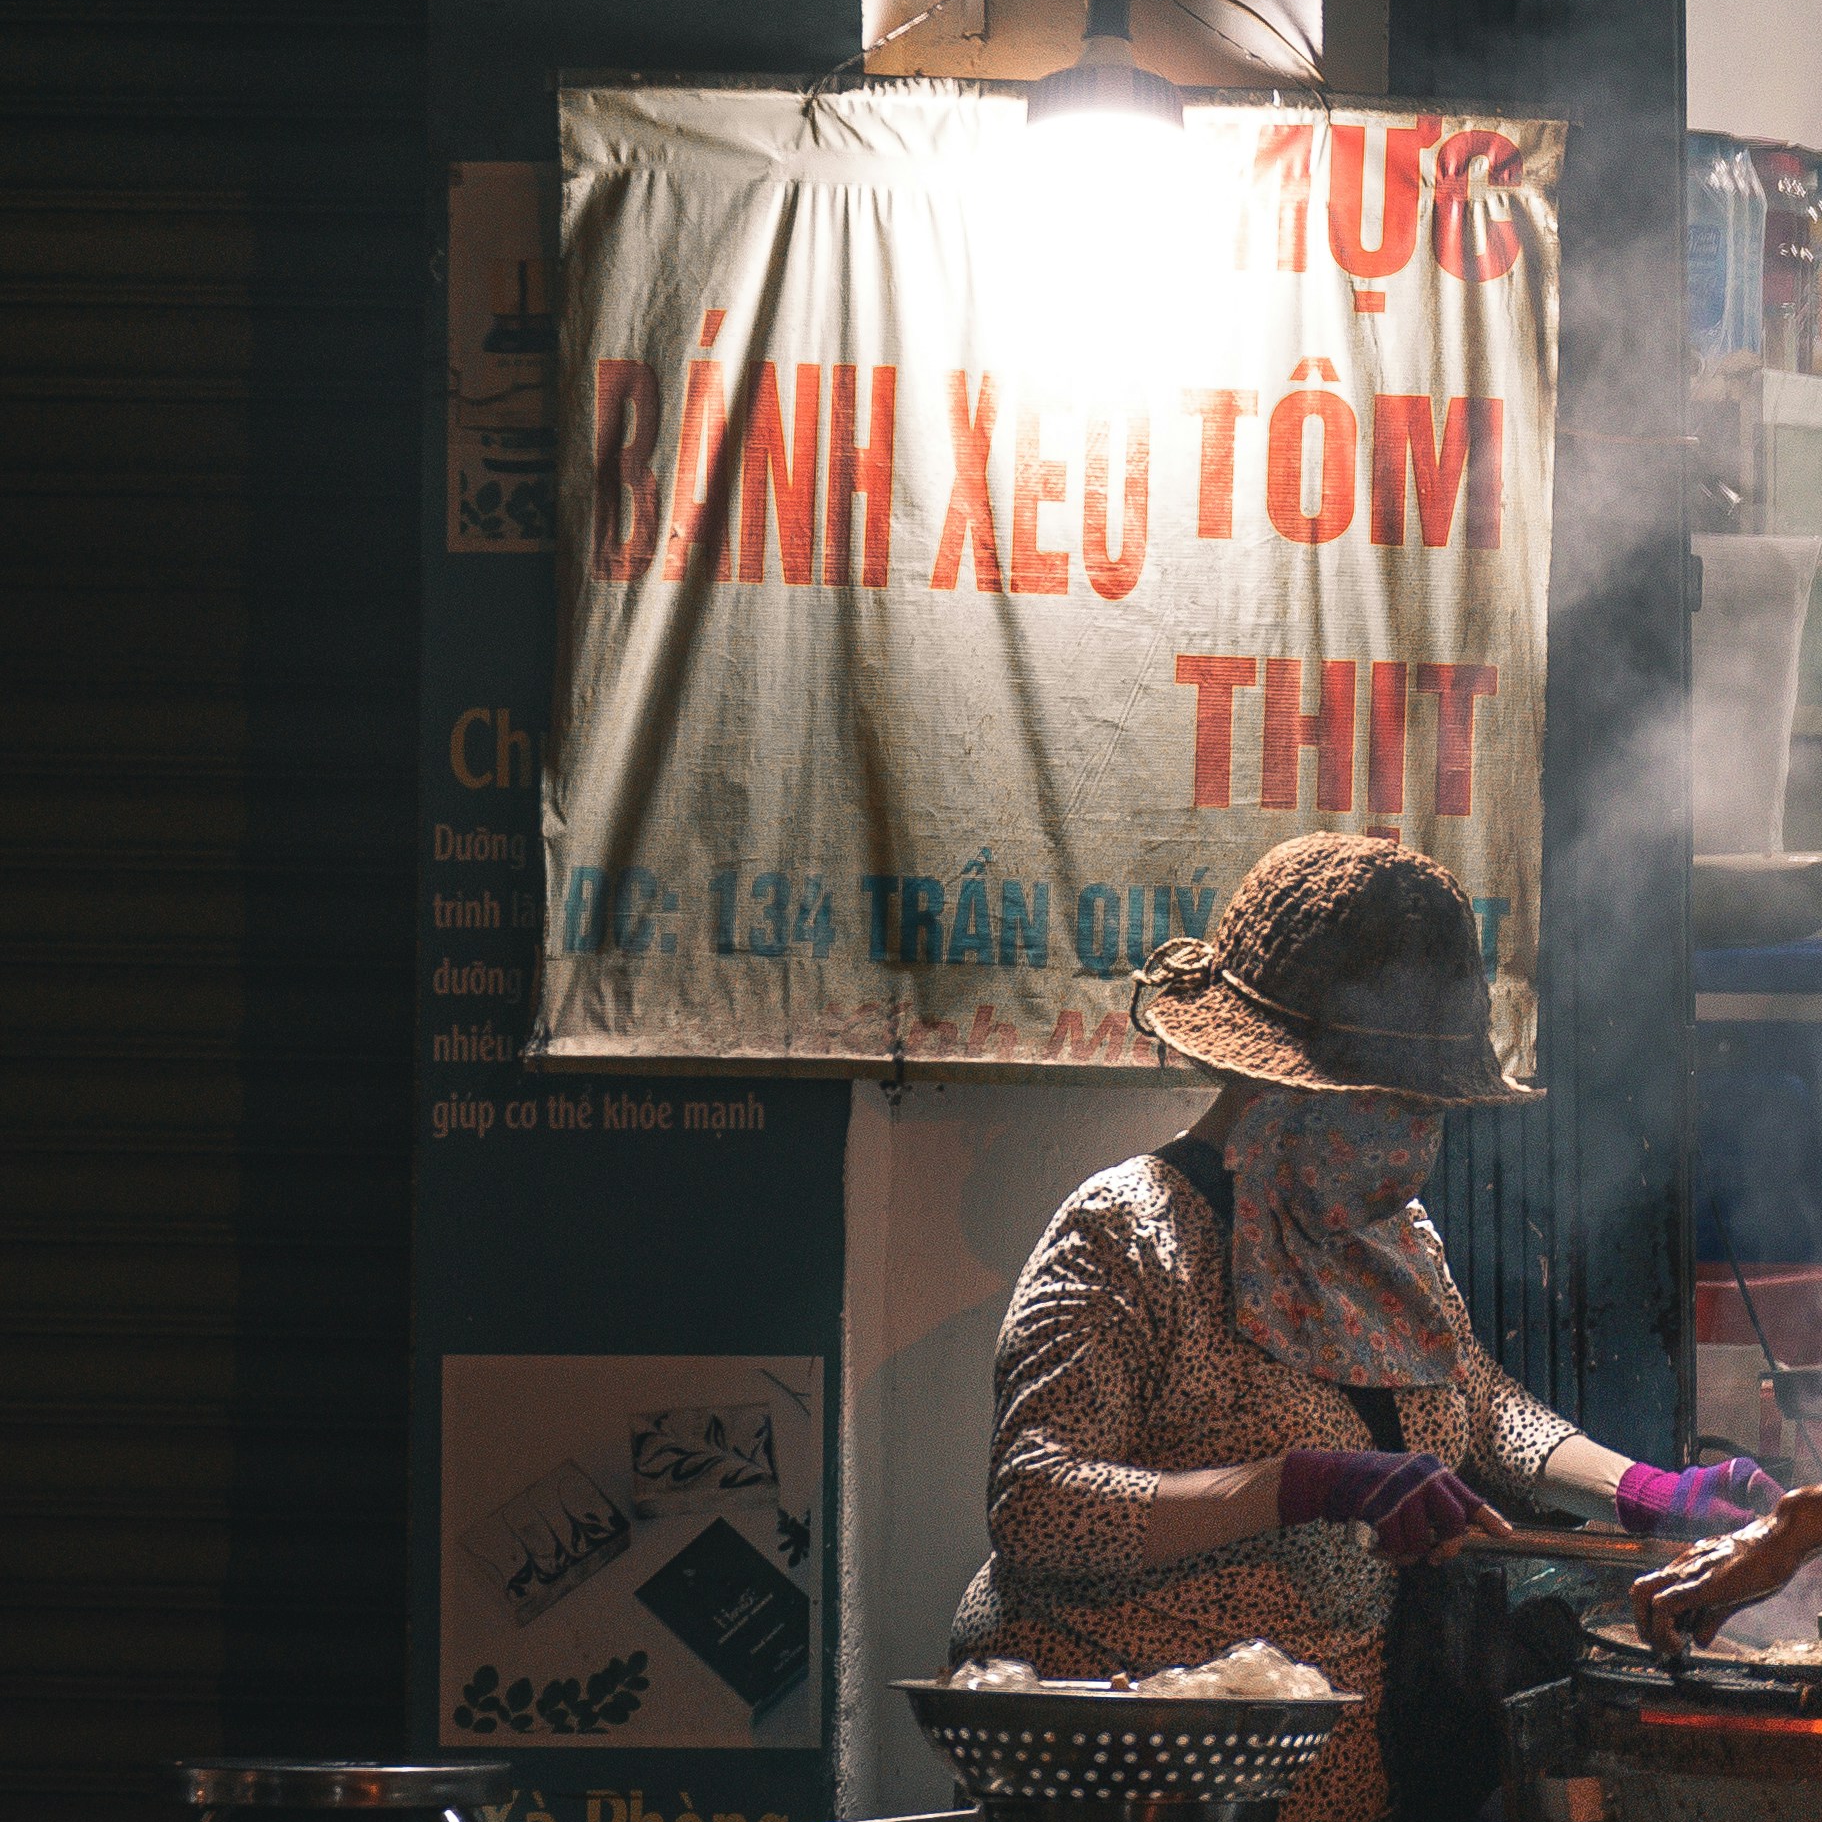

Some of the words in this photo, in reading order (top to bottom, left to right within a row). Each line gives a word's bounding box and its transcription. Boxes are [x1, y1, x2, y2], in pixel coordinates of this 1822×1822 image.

[598, 308, 897, 588] BÁNH
[1180, 356, 1504, 549] TÔM
[434, 823, 526, 870] Dưỡng
[709, 869, 836, 959] 134
[861, 846, 1049, 970] TRẦN
[1075, 866, 1216, 980] QUÝ
[433, 957, 523, 1005] dưỡng
[432, 1092, 495, 1139] giúp
[506, 1101, 538, 1131] cơ
[548, 1084, 594, 1131] thể
[684, 1093, 765, 1140] mạnh
